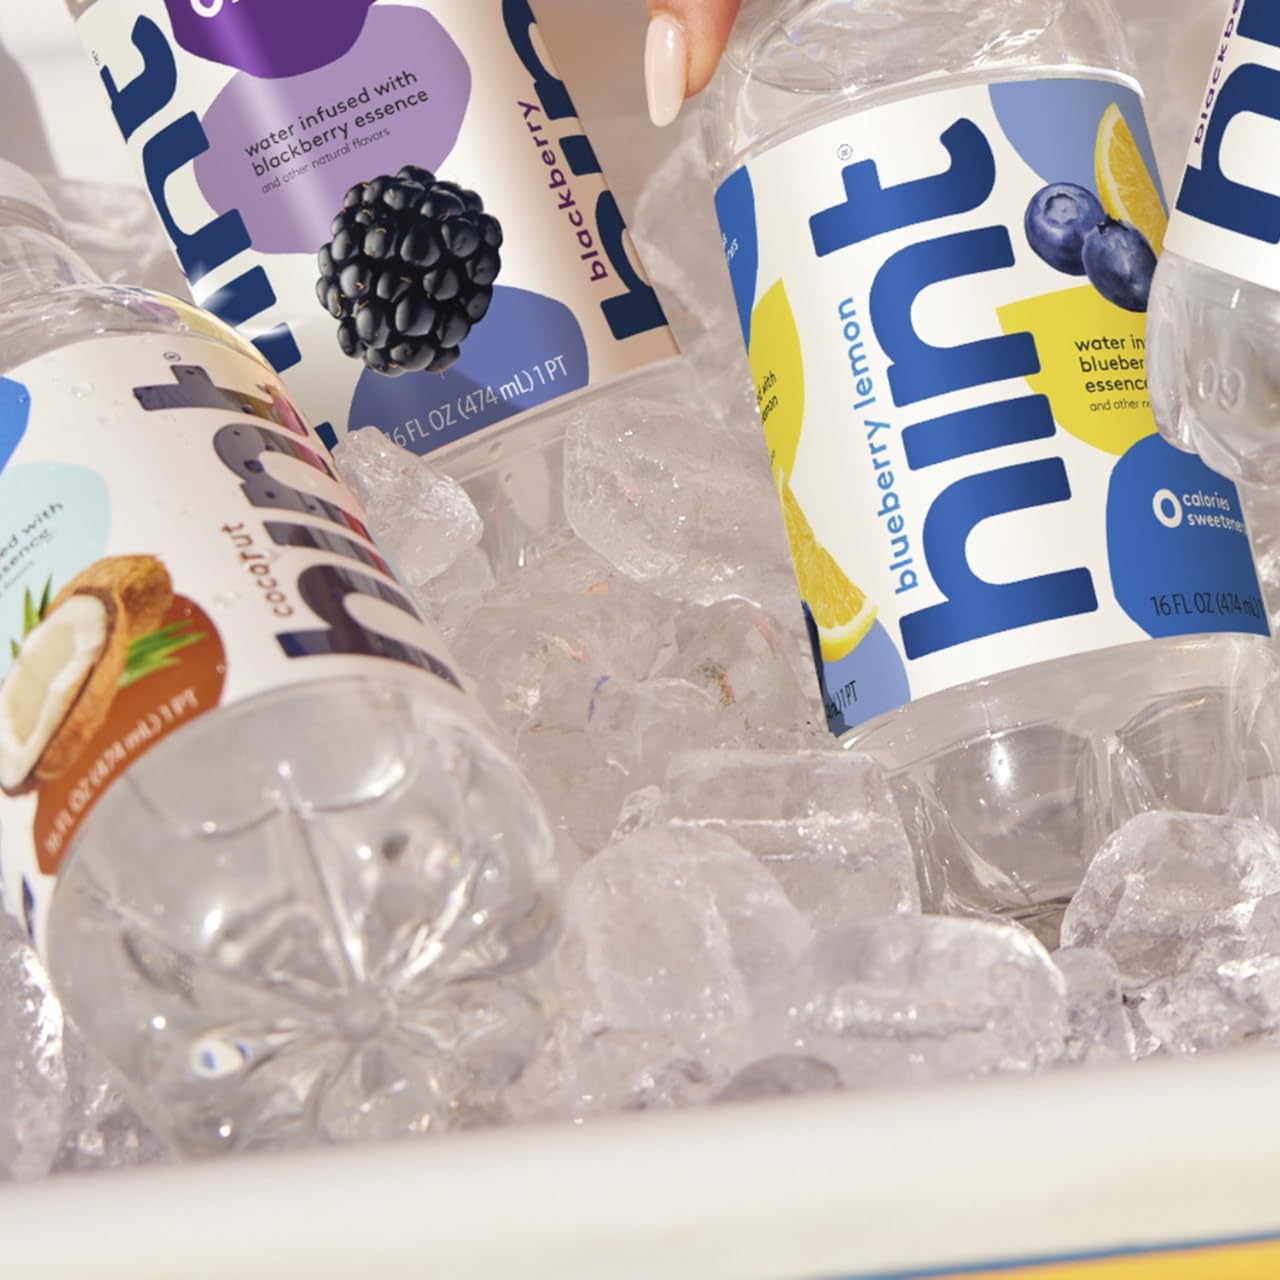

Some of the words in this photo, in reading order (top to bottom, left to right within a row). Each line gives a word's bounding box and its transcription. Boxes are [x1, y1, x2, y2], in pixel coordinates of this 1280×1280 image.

[245, 123, 295, 157] water
[298, 88, 370, 131] infused
[374, 71, 418, 97] with
[252, 122, 349, 176] blackberry
[355, 90, 429, 128] essence
[262, 178, 281, 194] and
[311, 143, 351, 167] natural
[352, 128, 390, 150] flavors
[516, 99, 608, 282] blackberry
[838, 296, 876, 410] lemon
[1074, 336, 1126, 351] water
[1079, 354, 1144, 372] blueber
[405, 418, 430, 443] FL
[429, 404, 457, 431] OZ
[457, 386, 499, 420] (474
[499, 370, 534, 401] mL)
[533, 366, 546, 385] 1
[545, 354, 568, 381] PT
[808, 117, 1099, 661] hint
[1089, 400, 1111, 412] and
[1113, 398, 1138, 409] other
[863, 418, 919, 595] blueberry
[1152, 488, 1183, 528] 0
[1182, 490, 1230, 511] calories
[1151, 594, 1171, 616] 16
[1173, 593, 1192, 615] FL
[1193, 592, 1215, 614] OZ
[845, 680, 857, 705] PT
